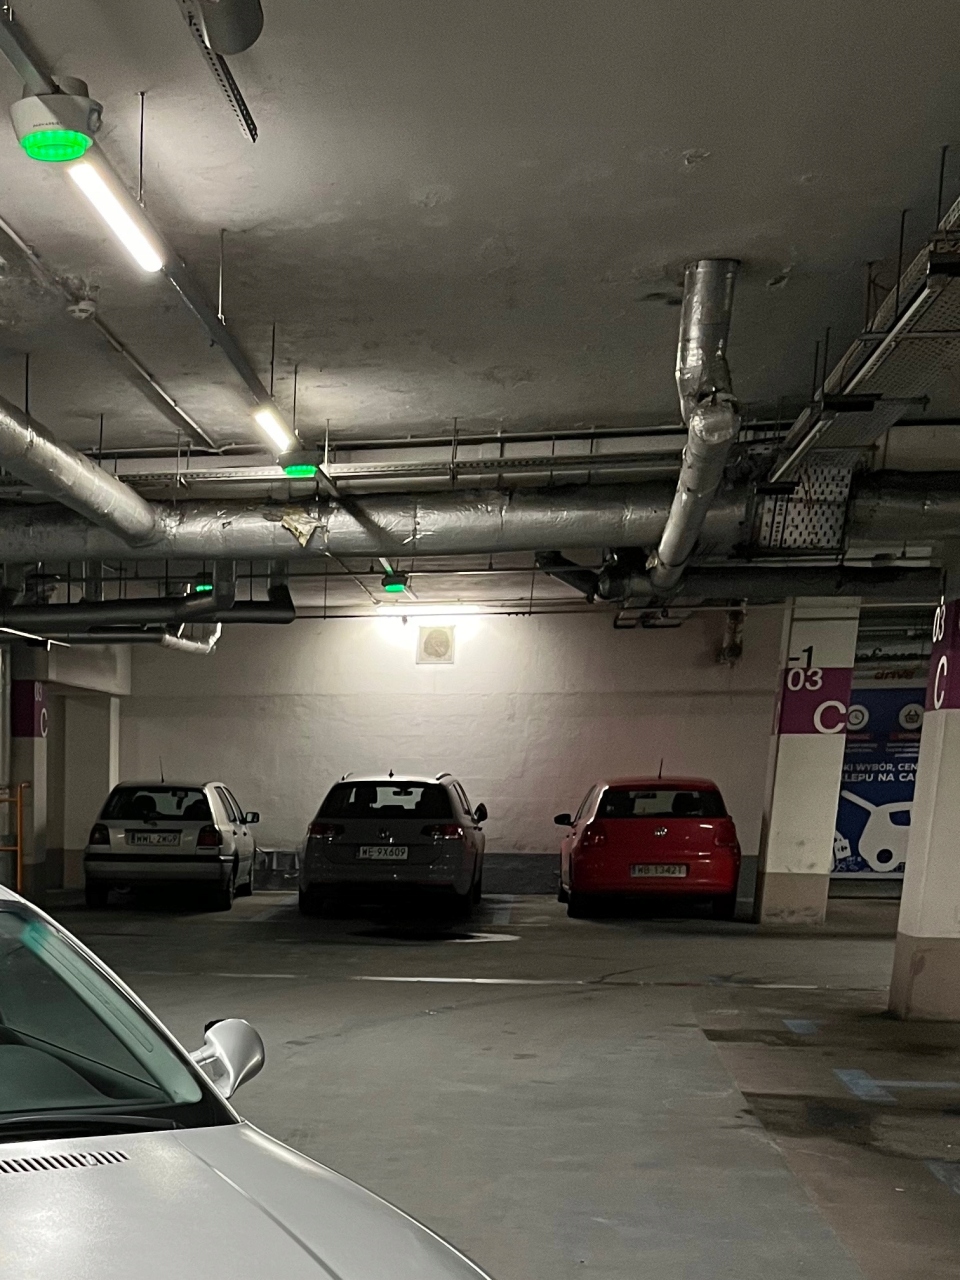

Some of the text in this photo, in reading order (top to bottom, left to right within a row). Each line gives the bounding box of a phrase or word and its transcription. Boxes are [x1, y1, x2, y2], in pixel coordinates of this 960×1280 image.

[932, 604, 946, 643] 03
[787, 667, 823, 691] 03
[934, 655, 948, 710] C
[41, 708, 48, 738] C
[813, 700, 847, 734] C
[842, 772, 916, 782] LEPU NA CA
[855, 760, 896, 772] WYBÓR,
[362, 848, 406, 857] WE 9X609
